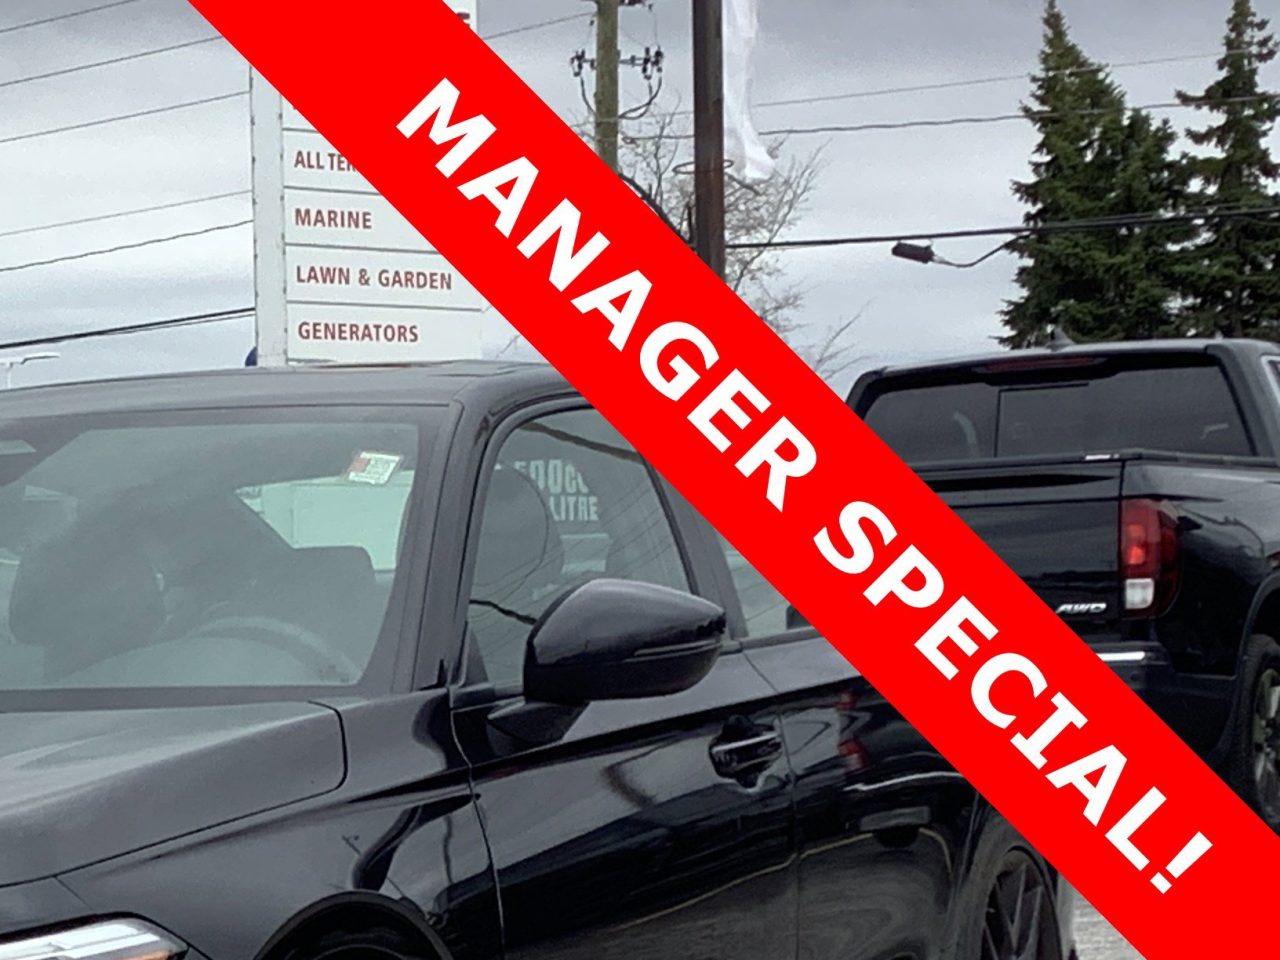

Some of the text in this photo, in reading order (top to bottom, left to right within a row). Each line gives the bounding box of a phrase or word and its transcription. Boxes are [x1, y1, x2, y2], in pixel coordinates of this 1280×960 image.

[294, 150, 324, 169] ALL
[295, 208, 372, 229] MARINE
[296, 265, 452, 290] LAWN & GARDEN
[298, 321, 419, 342] GENERATORS
[1056, 602, 1107, 613] AWD
